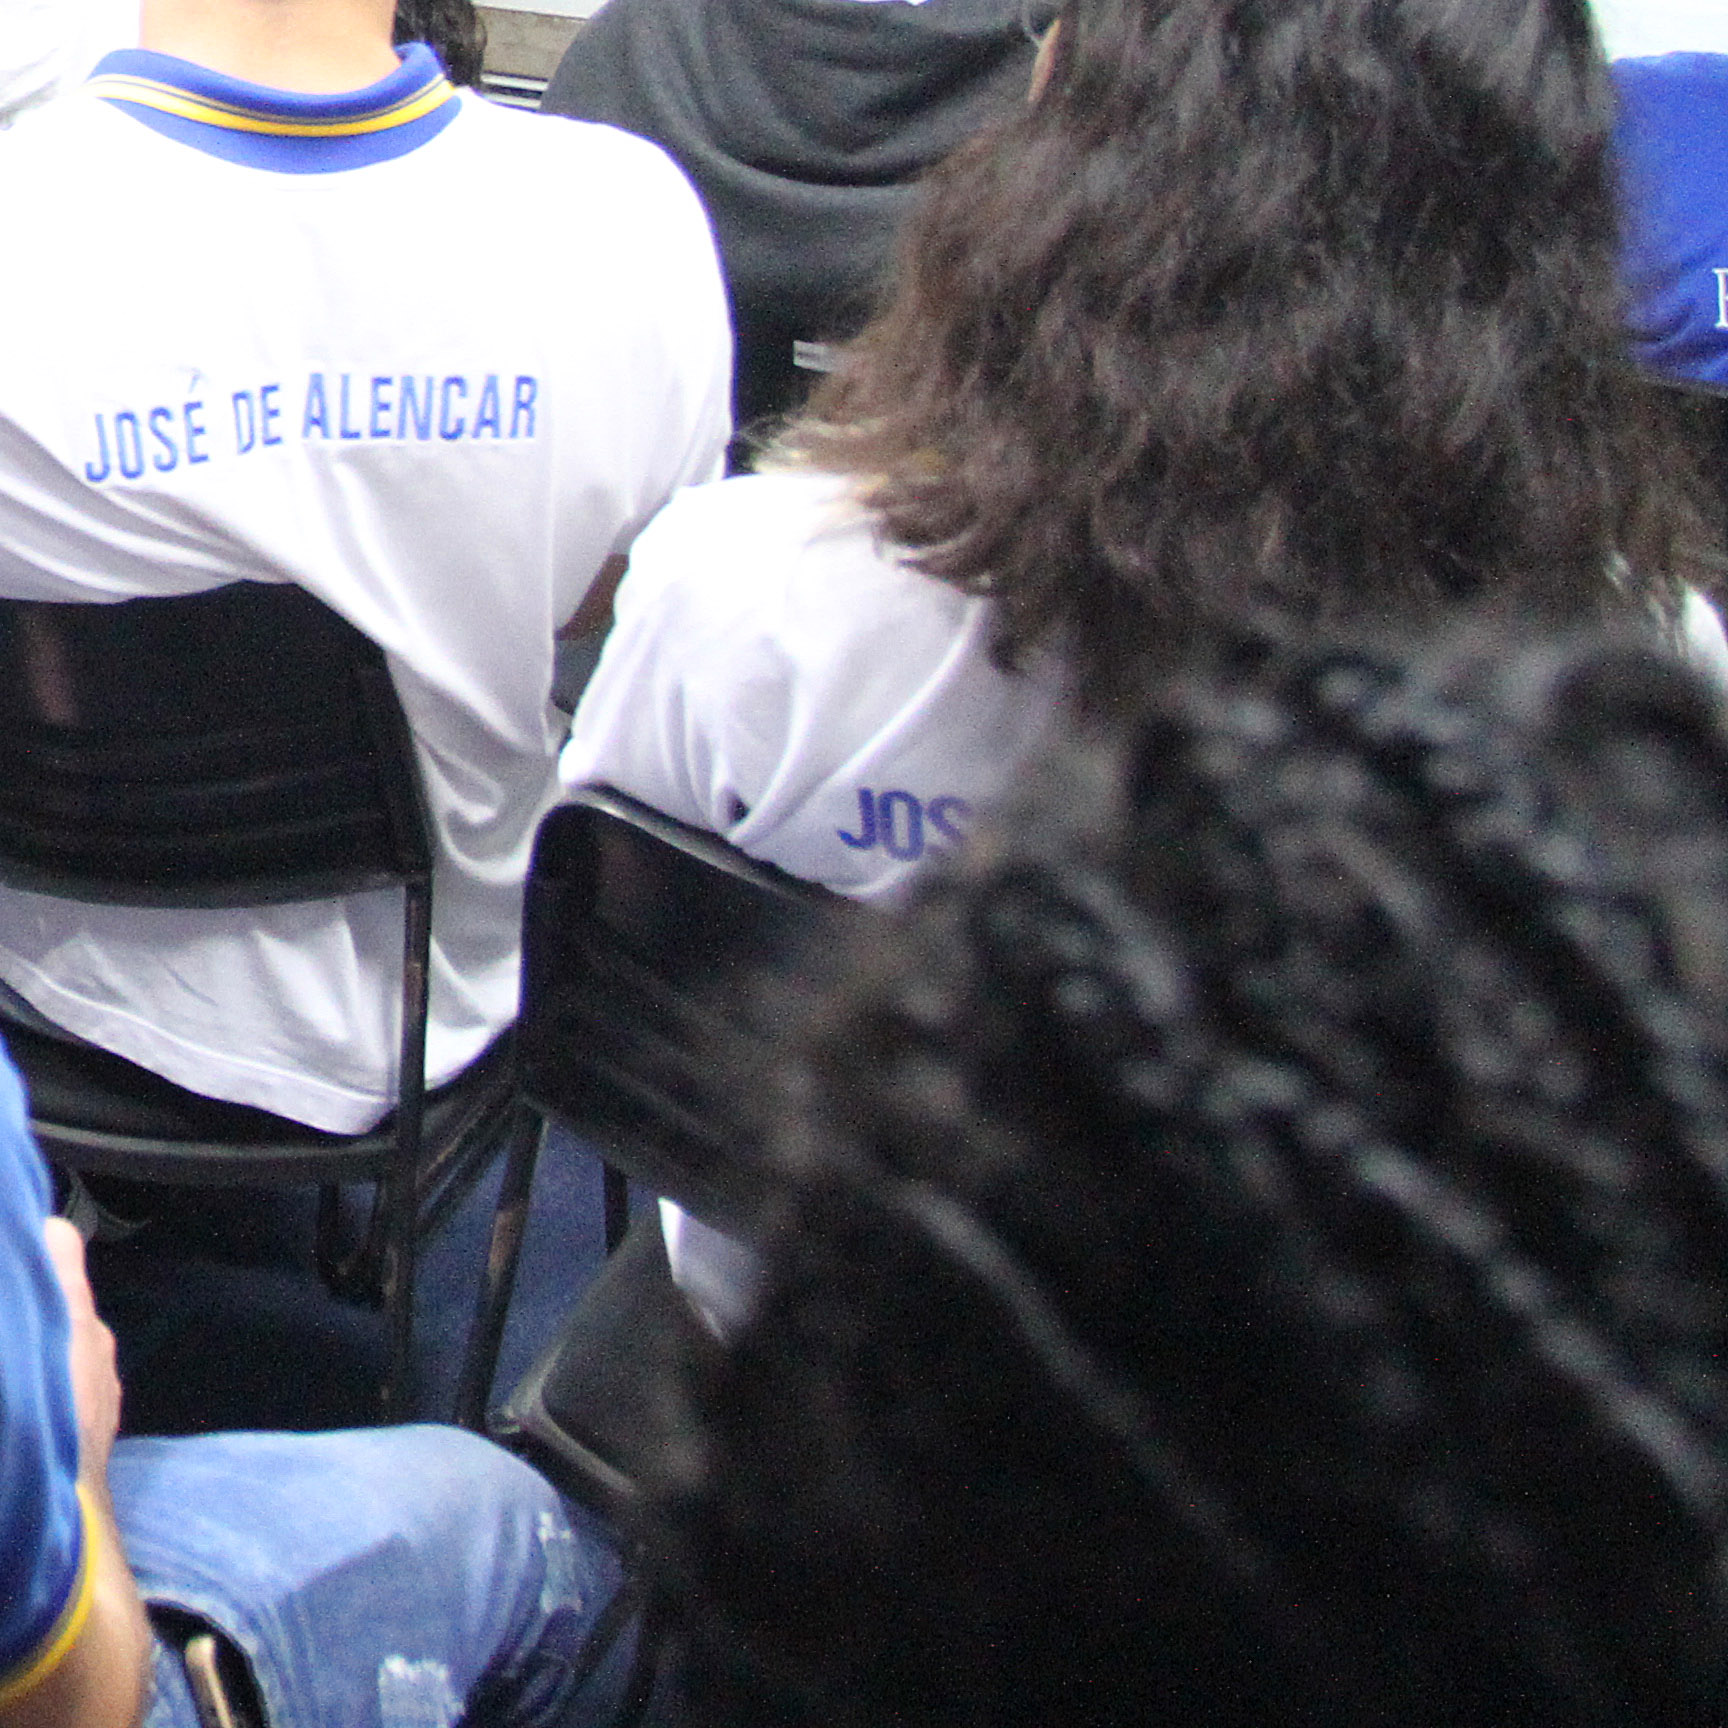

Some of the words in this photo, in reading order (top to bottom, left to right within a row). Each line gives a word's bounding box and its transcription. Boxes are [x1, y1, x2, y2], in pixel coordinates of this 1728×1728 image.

[85, 373, 210, 483] JOSÉ
[231, 383, 283, 455] DE
[301, 372, 538, 441] ALENCAR
[837, 786, 974, 862] JOS
